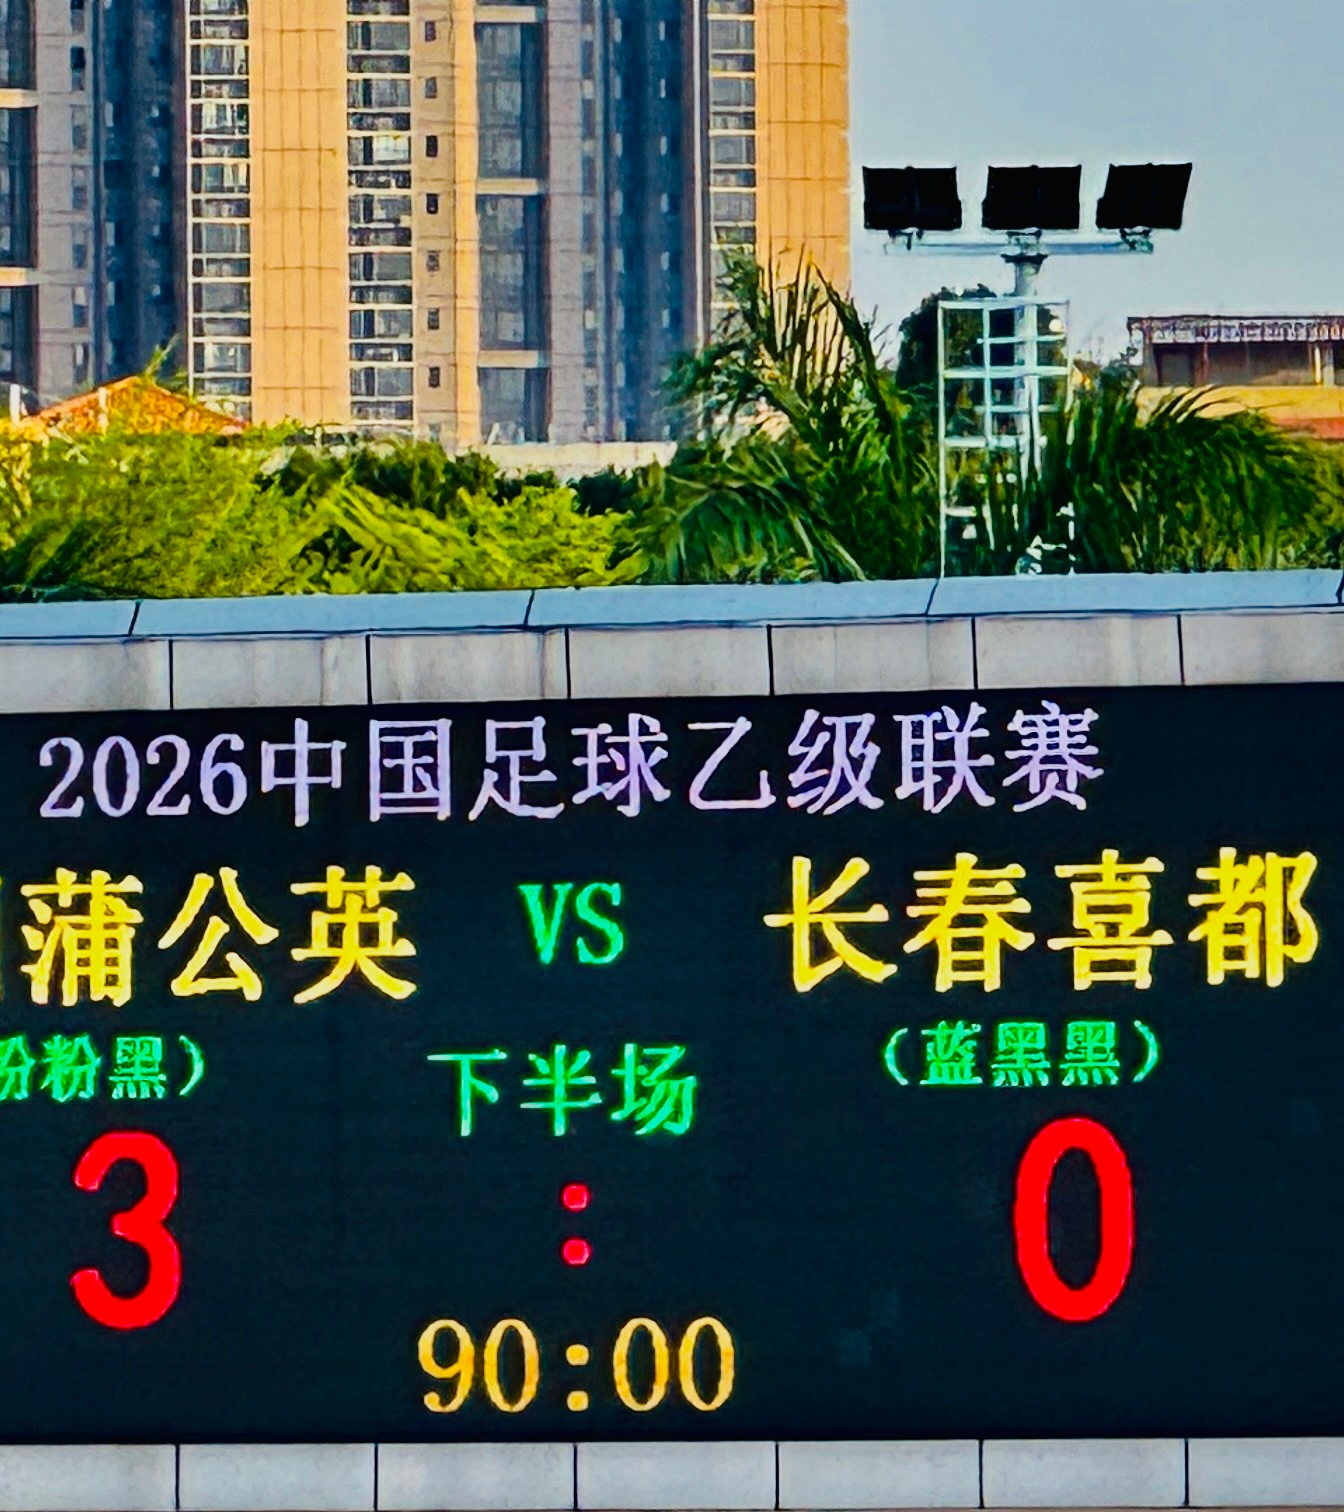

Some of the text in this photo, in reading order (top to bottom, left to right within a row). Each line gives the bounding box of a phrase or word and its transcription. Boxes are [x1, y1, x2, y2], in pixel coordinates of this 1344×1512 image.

[37, 703, 1104, 827] 2026中国足球乙级联赛
[518, 881, 625, 965] VS
[762, 847, 1319, 993] 长春喜都
[426, 1042, 698, 1137] 下半场
[69, 1117, 1135, 1331] 3 : 0
[418, 1316, 735, 1413] 90:00
